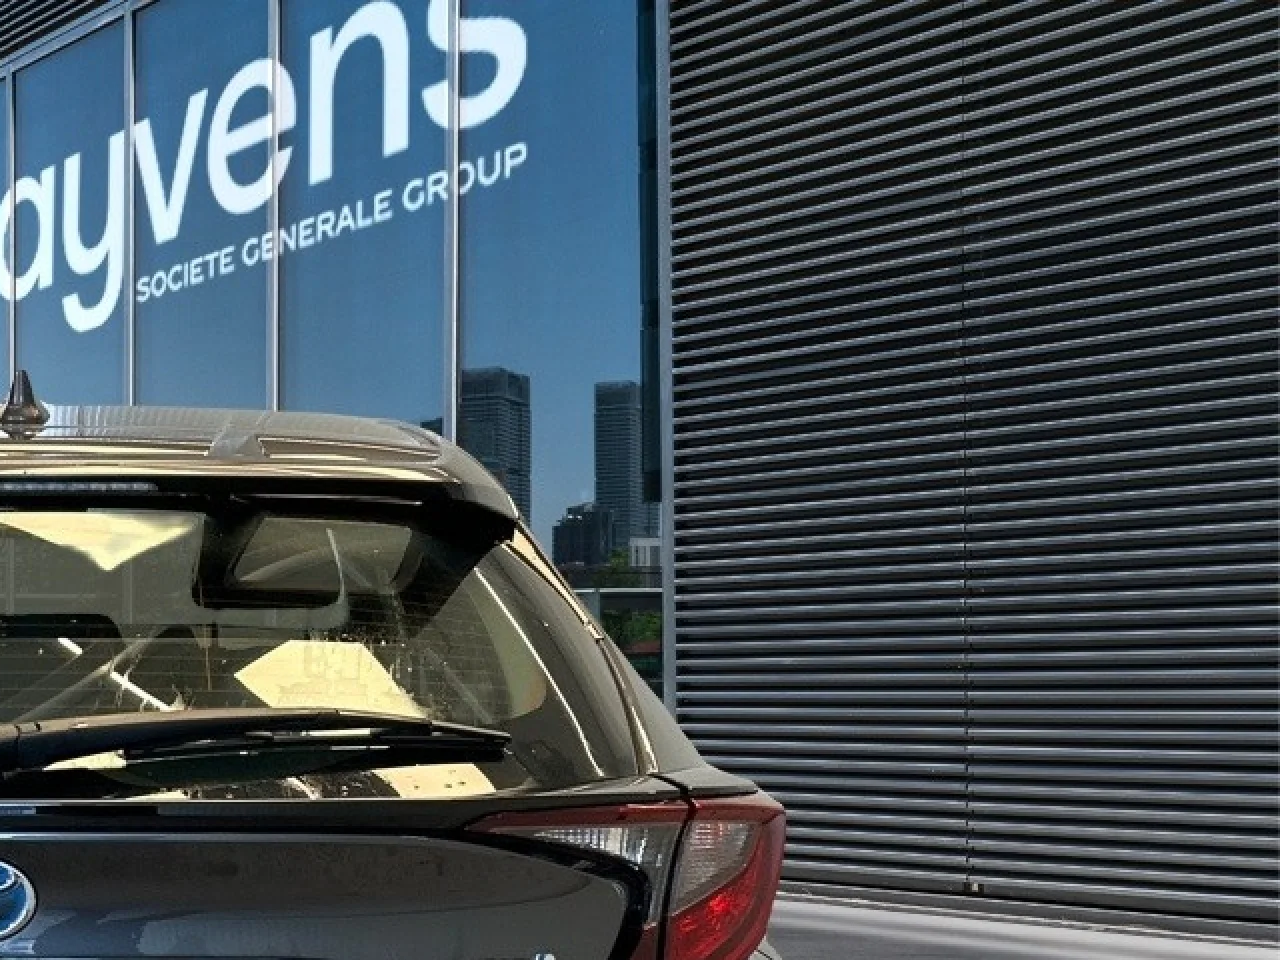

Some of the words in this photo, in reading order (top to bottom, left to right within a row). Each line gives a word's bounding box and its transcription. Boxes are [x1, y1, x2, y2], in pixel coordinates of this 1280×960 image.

[135, 245, 236, 303] SOCIETE
[240, 190, 394, 263] GENERALE
[402, 142, 528, 212] GROUP
